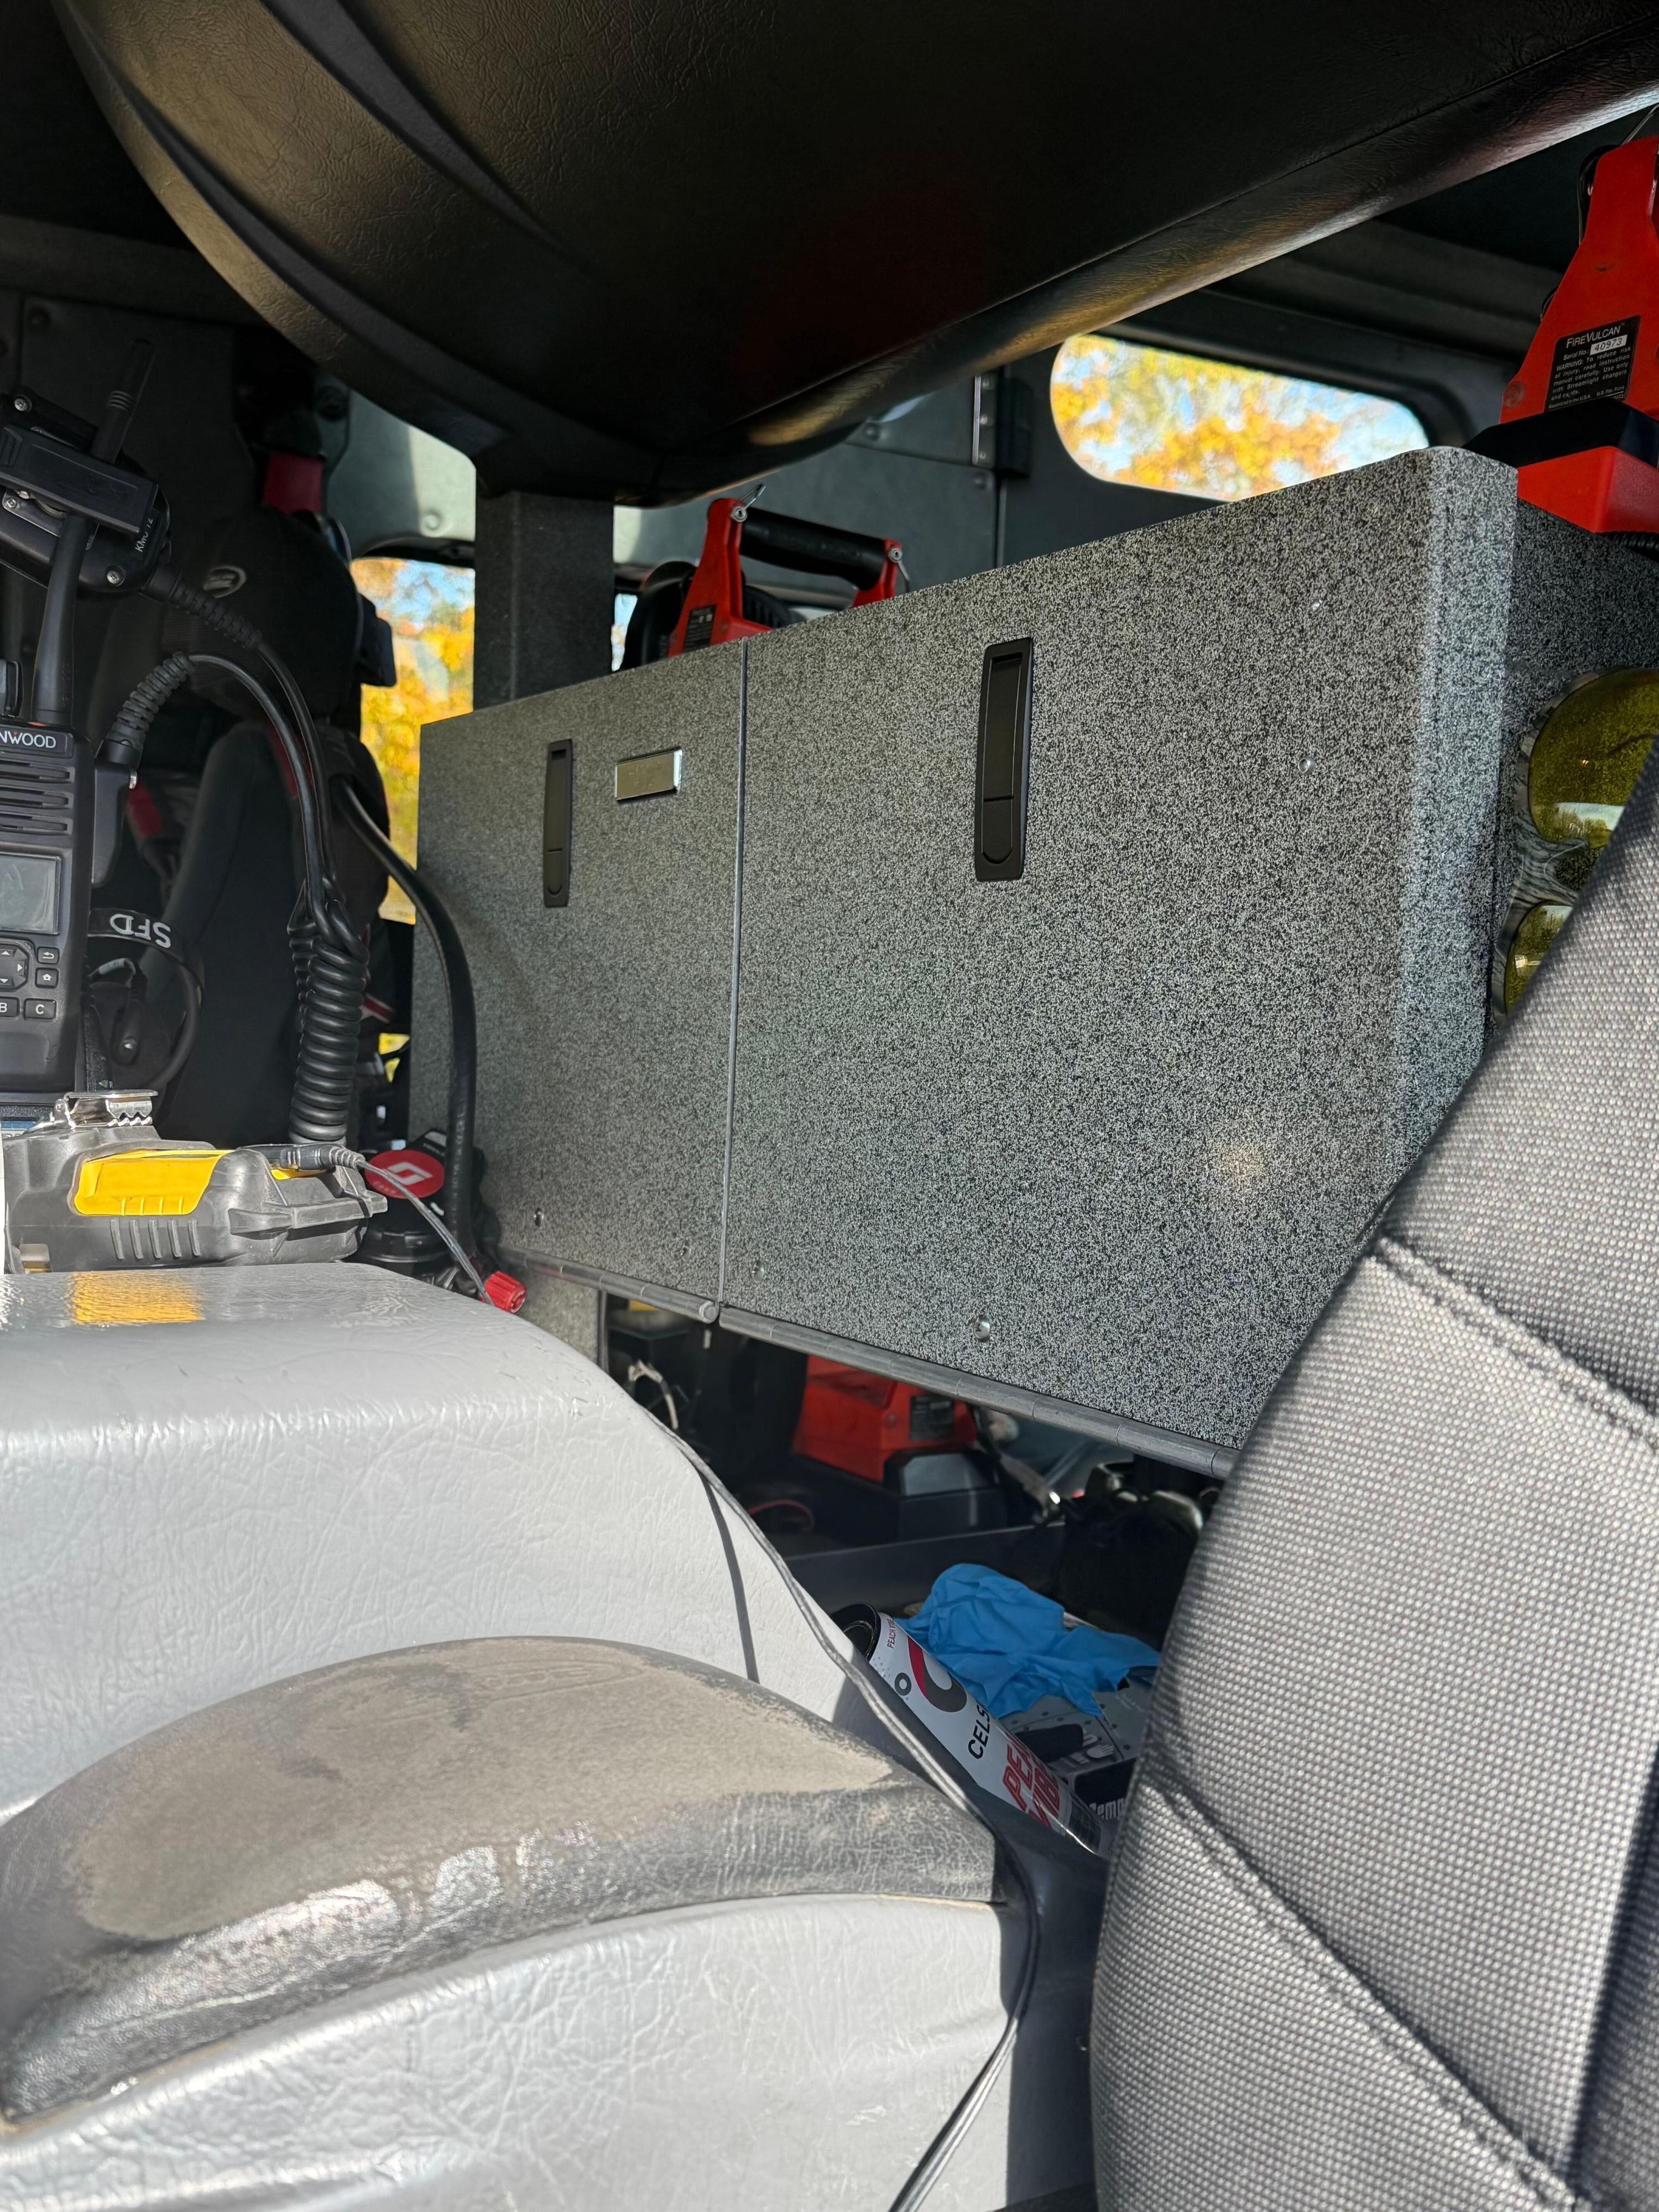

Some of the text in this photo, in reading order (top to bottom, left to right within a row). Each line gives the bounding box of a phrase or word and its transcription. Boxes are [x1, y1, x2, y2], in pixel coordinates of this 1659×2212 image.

[1563, 352, 1578, 360] Serial
[1594, 337, 1623, 352] 40973
[1557, 359, 1584, 371] WARNING:
[1597, 351, 1617, 359] reduce
[1599, 354, 1630, 366] instruction
[1553, 377, 1573, 385] manual
[1567, 377, 1599, 389] Streamlight
[110, 914, 171, 948] SFD
[35, 1004, 44, 1015] C
[887, 1629, 896, 1648] PEACH
